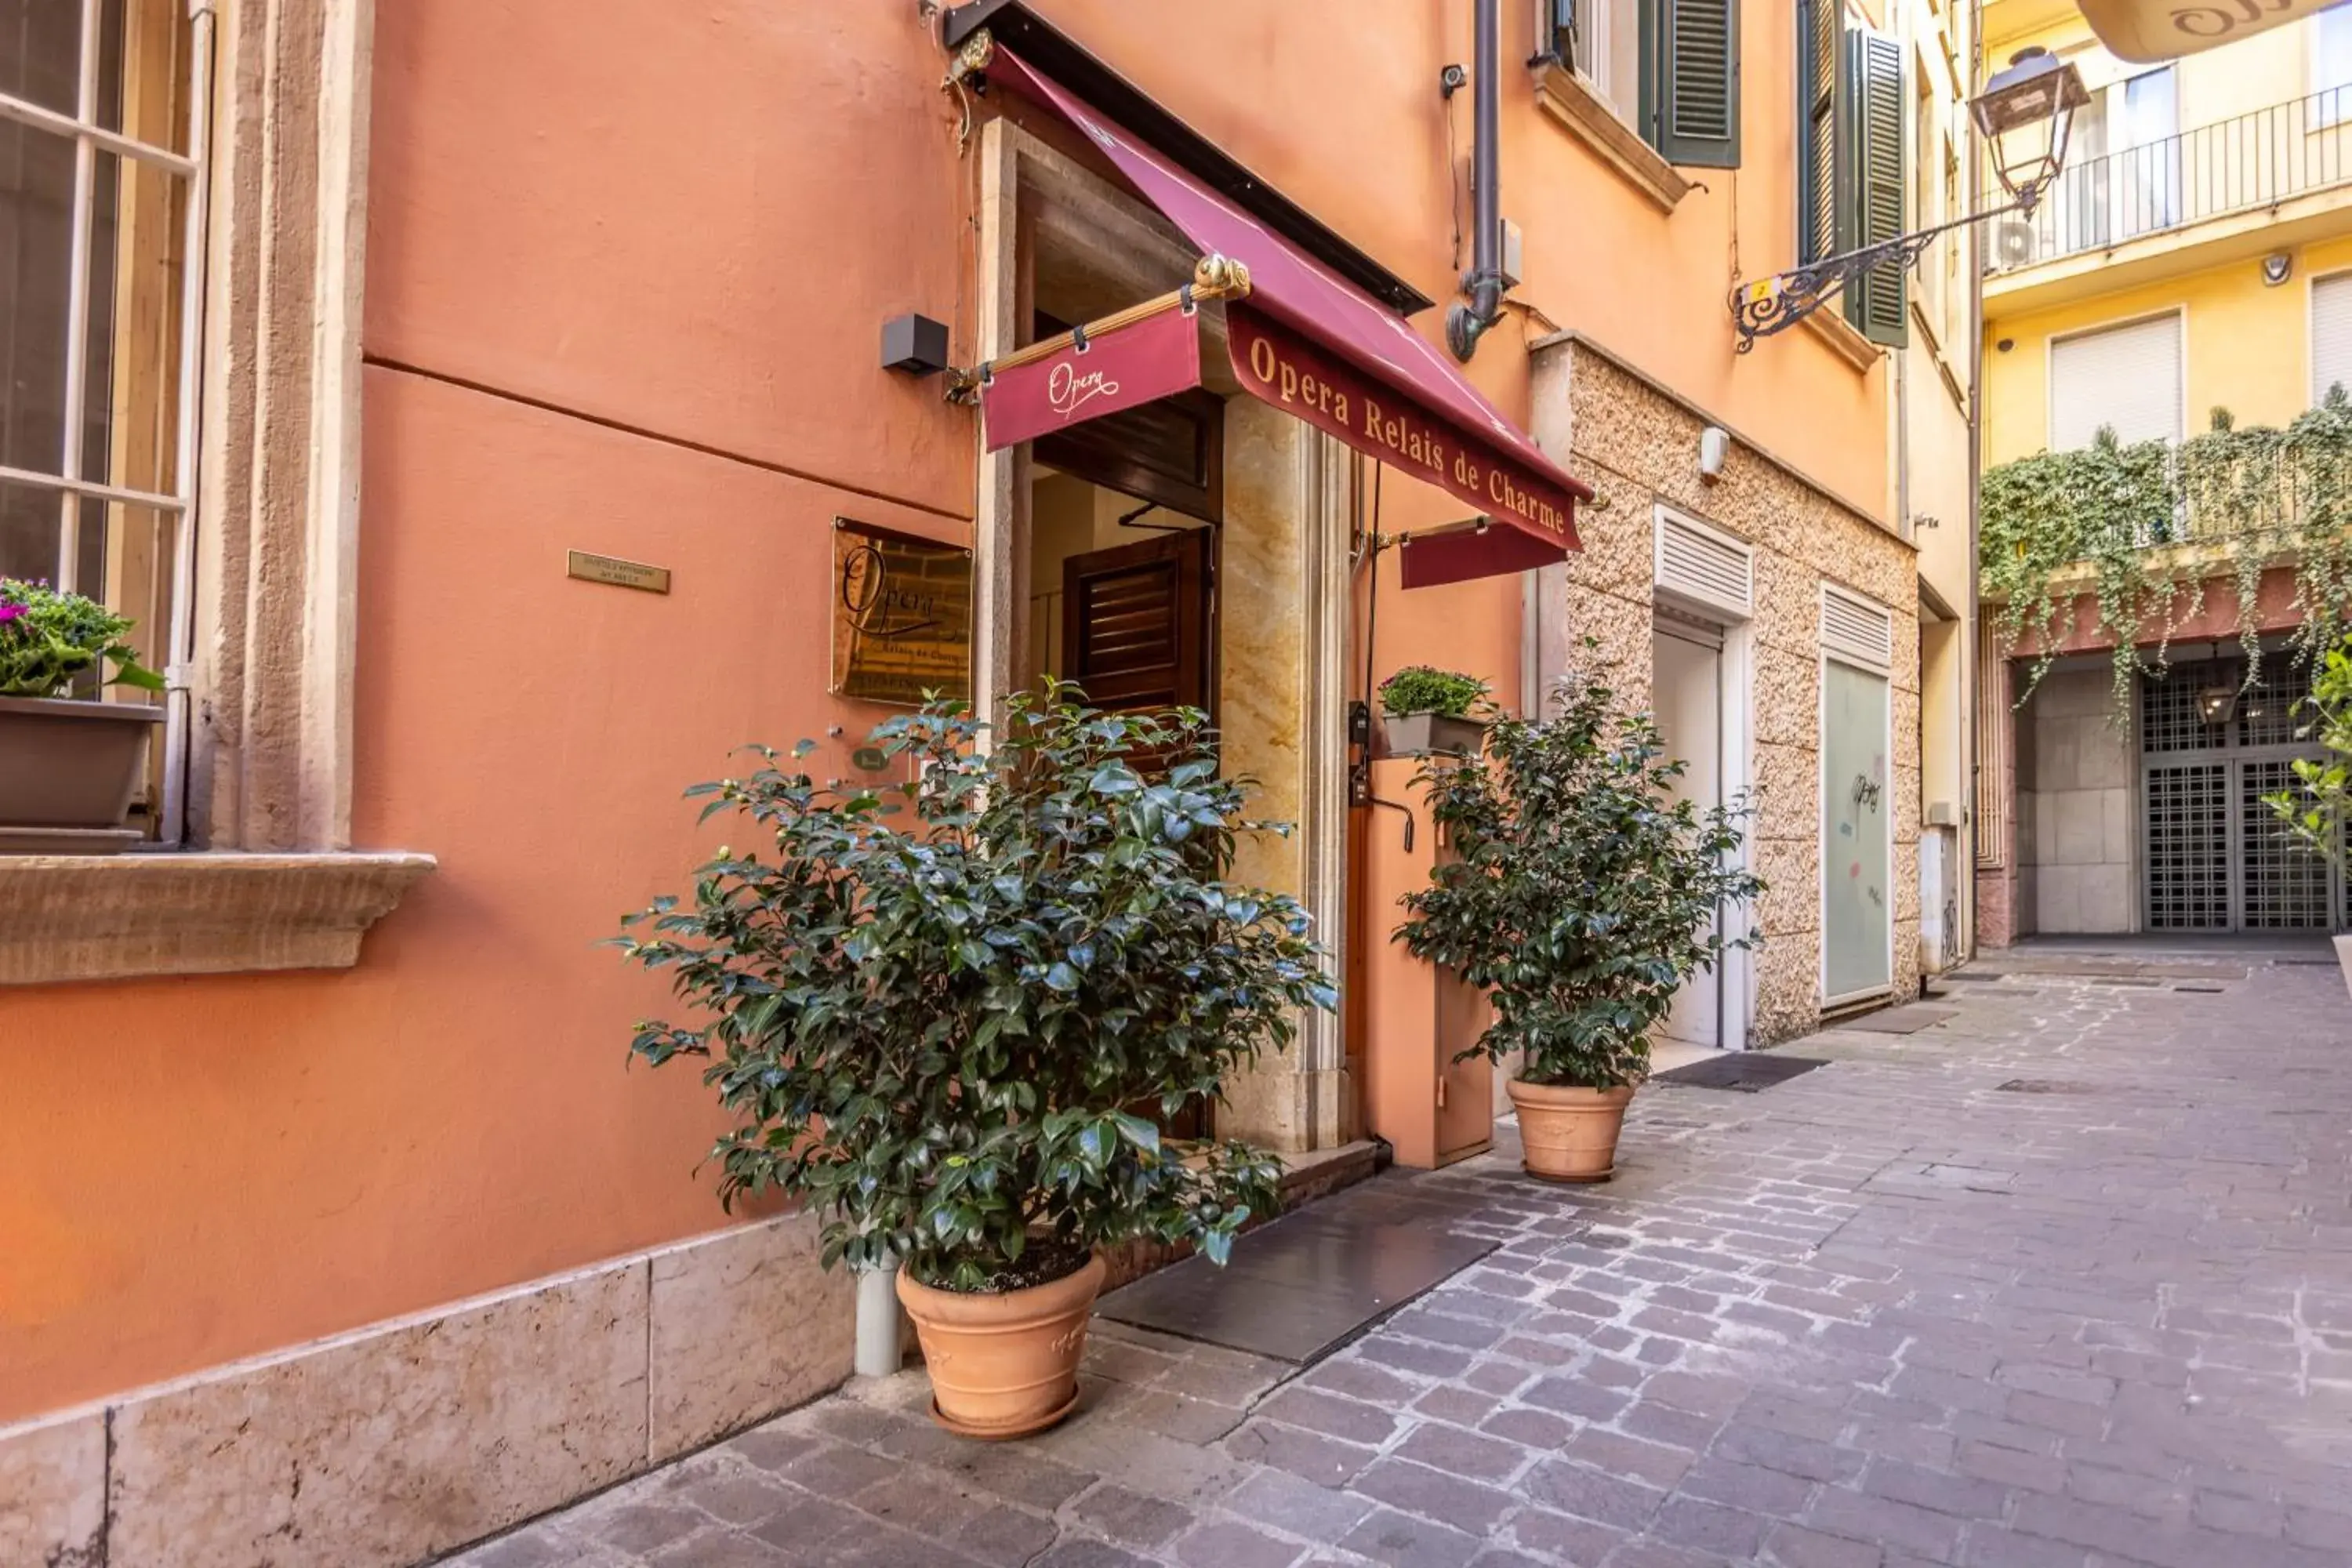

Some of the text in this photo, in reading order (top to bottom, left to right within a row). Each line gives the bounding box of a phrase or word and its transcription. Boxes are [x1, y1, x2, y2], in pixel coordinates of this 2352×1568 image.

[1050, 363, 1119, 419] Opera
[1250, 337, 1564, 534] Opera Relais de Charme
[842, 545, 944, 637] Opera
